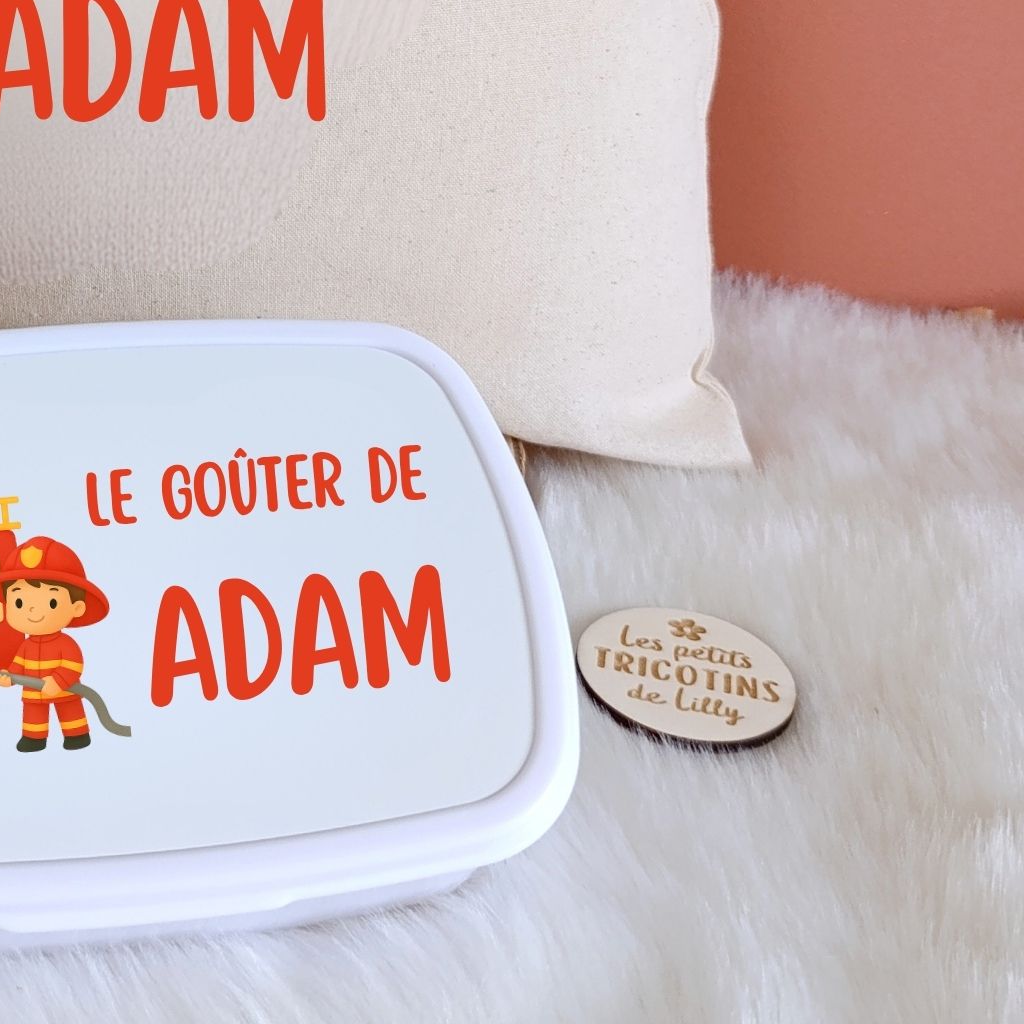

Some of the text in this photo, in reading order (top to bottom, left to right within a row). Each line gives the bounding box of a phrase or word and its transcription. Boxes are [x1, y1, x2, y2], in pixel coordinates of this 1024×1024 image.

[86, 444, 427, 527] LE GOÛTER DE
[151, 564, 451, 708] ADAM
[619, 624, 752, 669] Les petits
[594, 645, 781, 703] TRICOTINS
[627, 683, 744, 726] de Lilly
